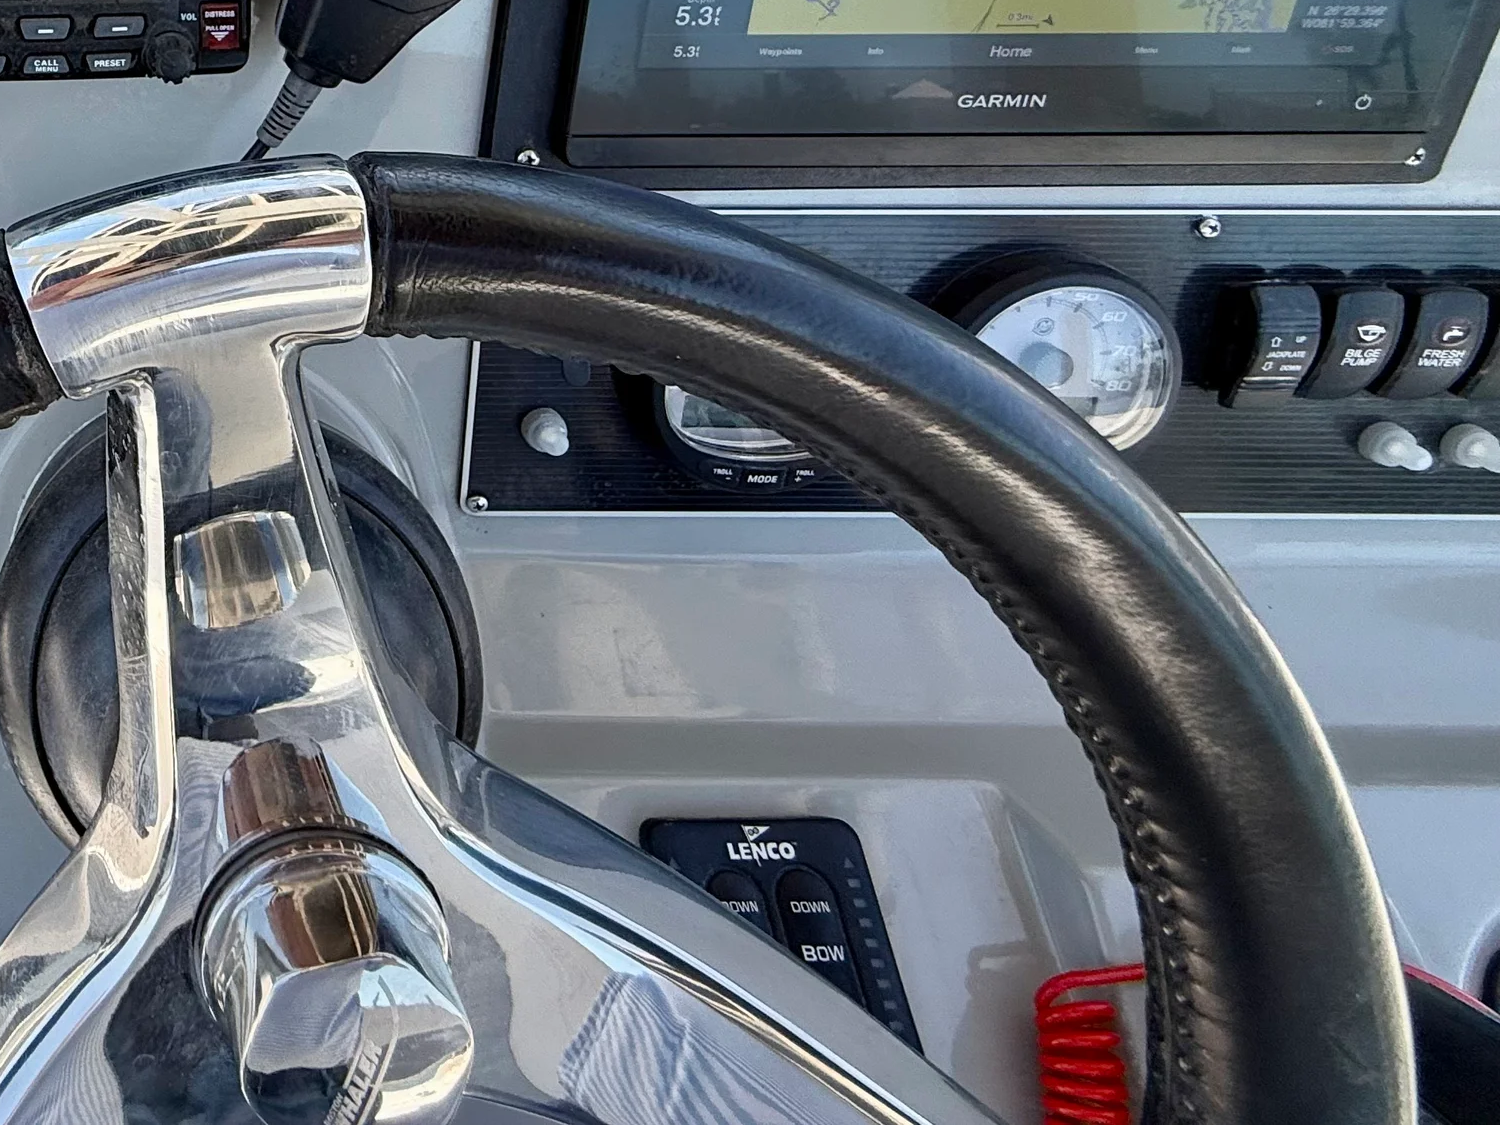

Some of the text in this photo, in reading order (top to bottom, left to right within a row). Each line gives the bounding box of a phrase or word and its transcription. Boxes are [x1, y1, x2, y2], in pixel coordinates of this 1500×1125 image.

[180, 13, 197, 21] VOL
[204, 10, 235, 19] DISTRESS
[675, 6, 713, 26] 5.3
[759, 48, 803, 57] Waypoints
[867, 47, 885, 55] Info
[990, 45, 1033, 59] Home
[33, 59, 59, 67] CALL
[94, 58, 127, 68] PRESET
[957, 94, 1047, 108] GARMIN
[1073, 292, 1100, 302] 50
[1101, 311, 1128, 322] 60
[1113, 345, 1137, 357] 70
[1344, 348, 1383, 358] BILGE
[1422, 349, 1467, 358] FRESH
[1340, 357, 1378, 367] PUMP
[1417, 358, 1463, 367] WATER
[1105, 380, 1132, 391] 80
[713, 468, 733, 476] TROLL
[747, 475, 779, 484] MODE
[726, 842, 796, 861] LENCO
[790, 901, 831, 913] DOWN
[800, 944, 846, 963] BOW
